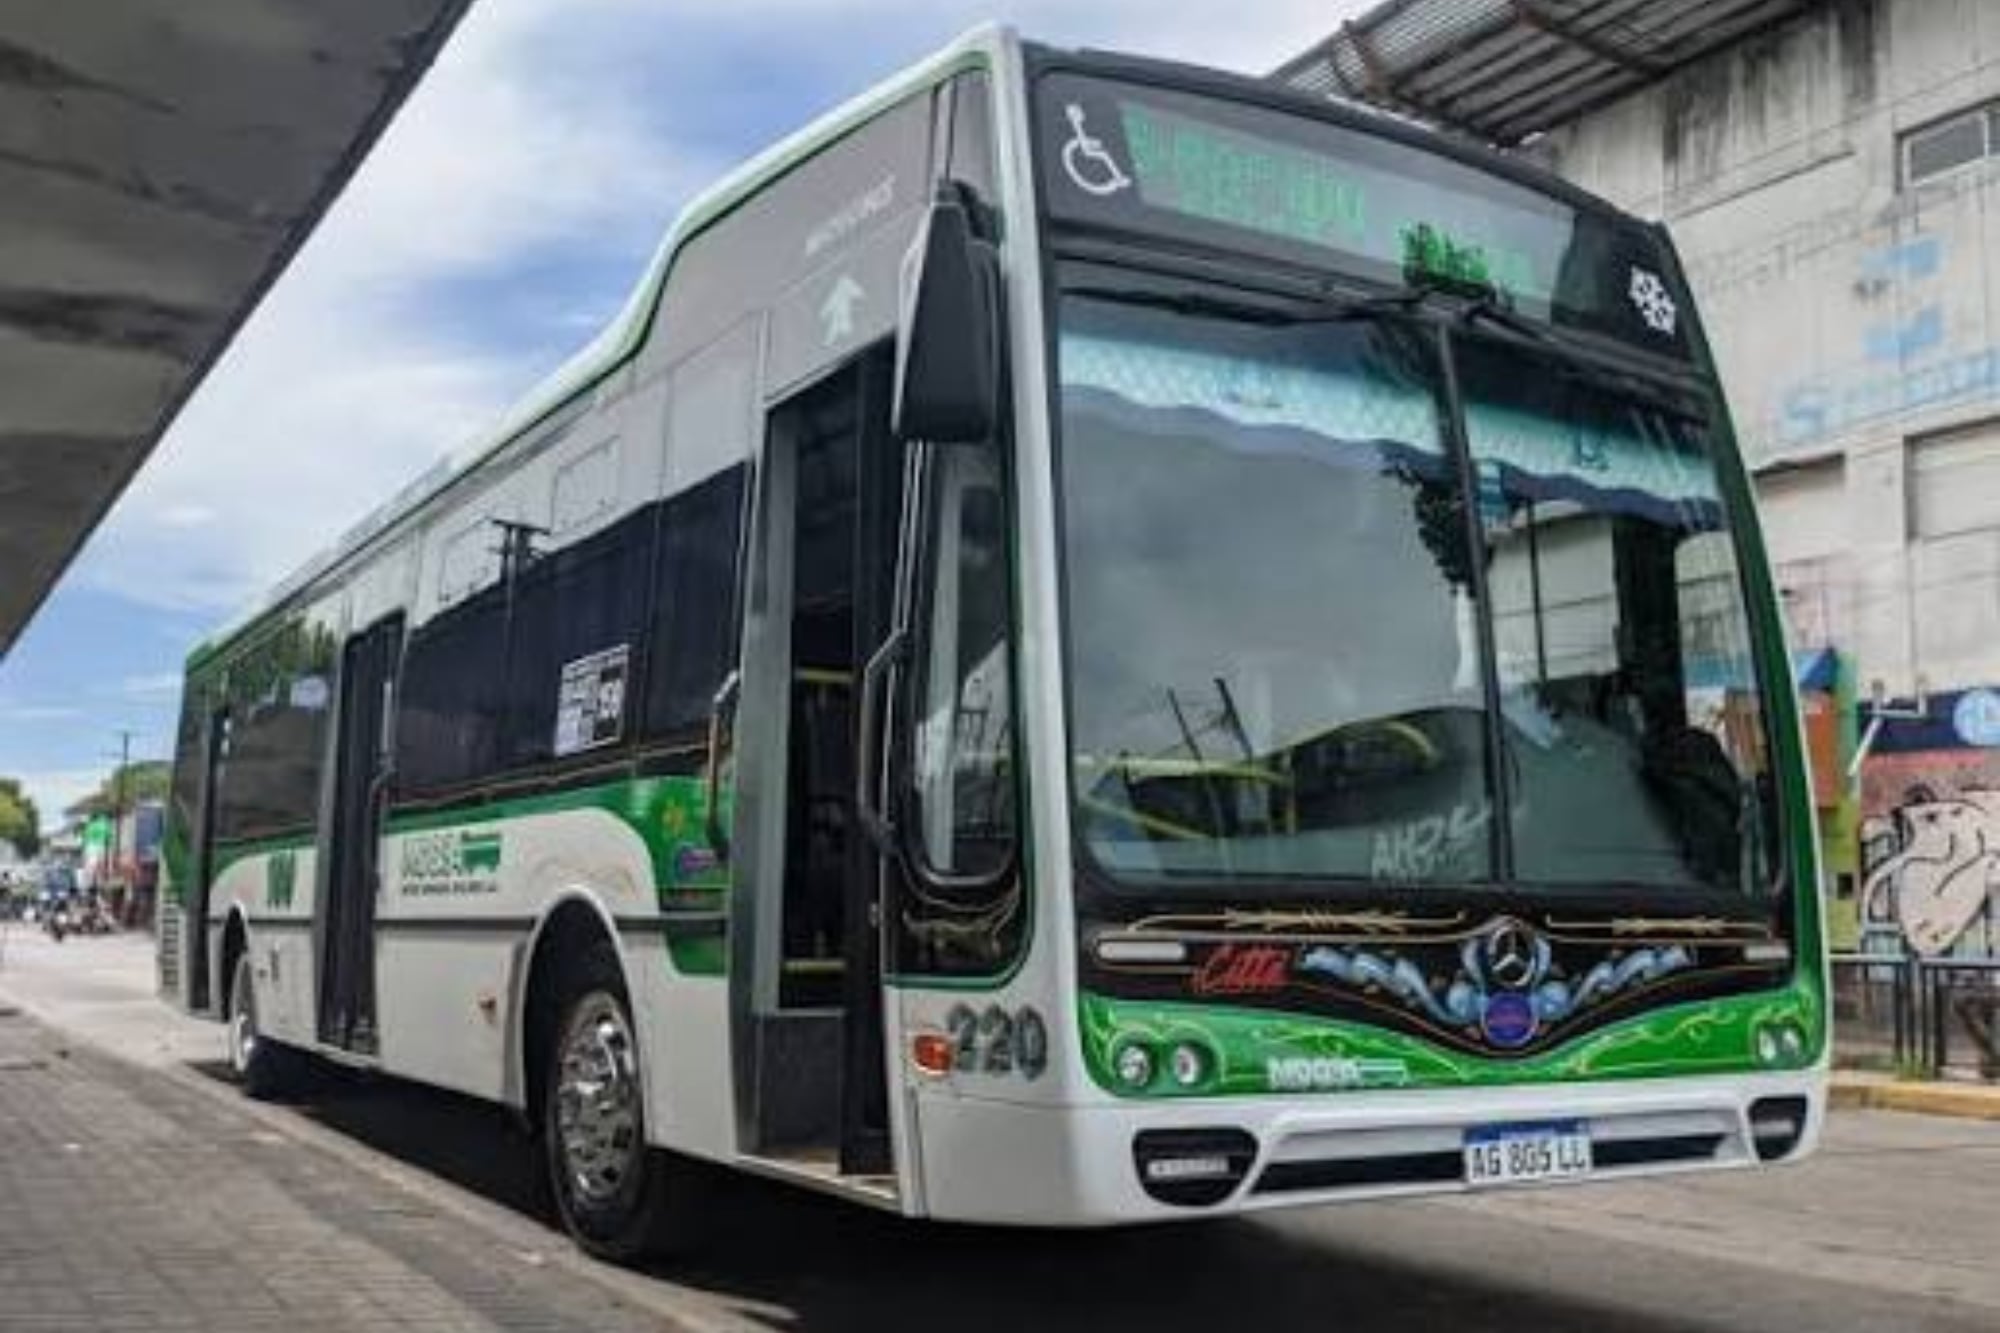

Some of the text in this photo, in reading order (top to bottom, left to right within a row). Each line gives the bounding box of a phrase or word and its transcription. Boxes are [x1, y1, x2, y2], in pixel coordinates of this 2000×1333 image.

[948, 1002, 1047, 1081] 220
[1472, 1146, 1501, 1179] AG
[1508, 1139, 1551, 1175] 805
